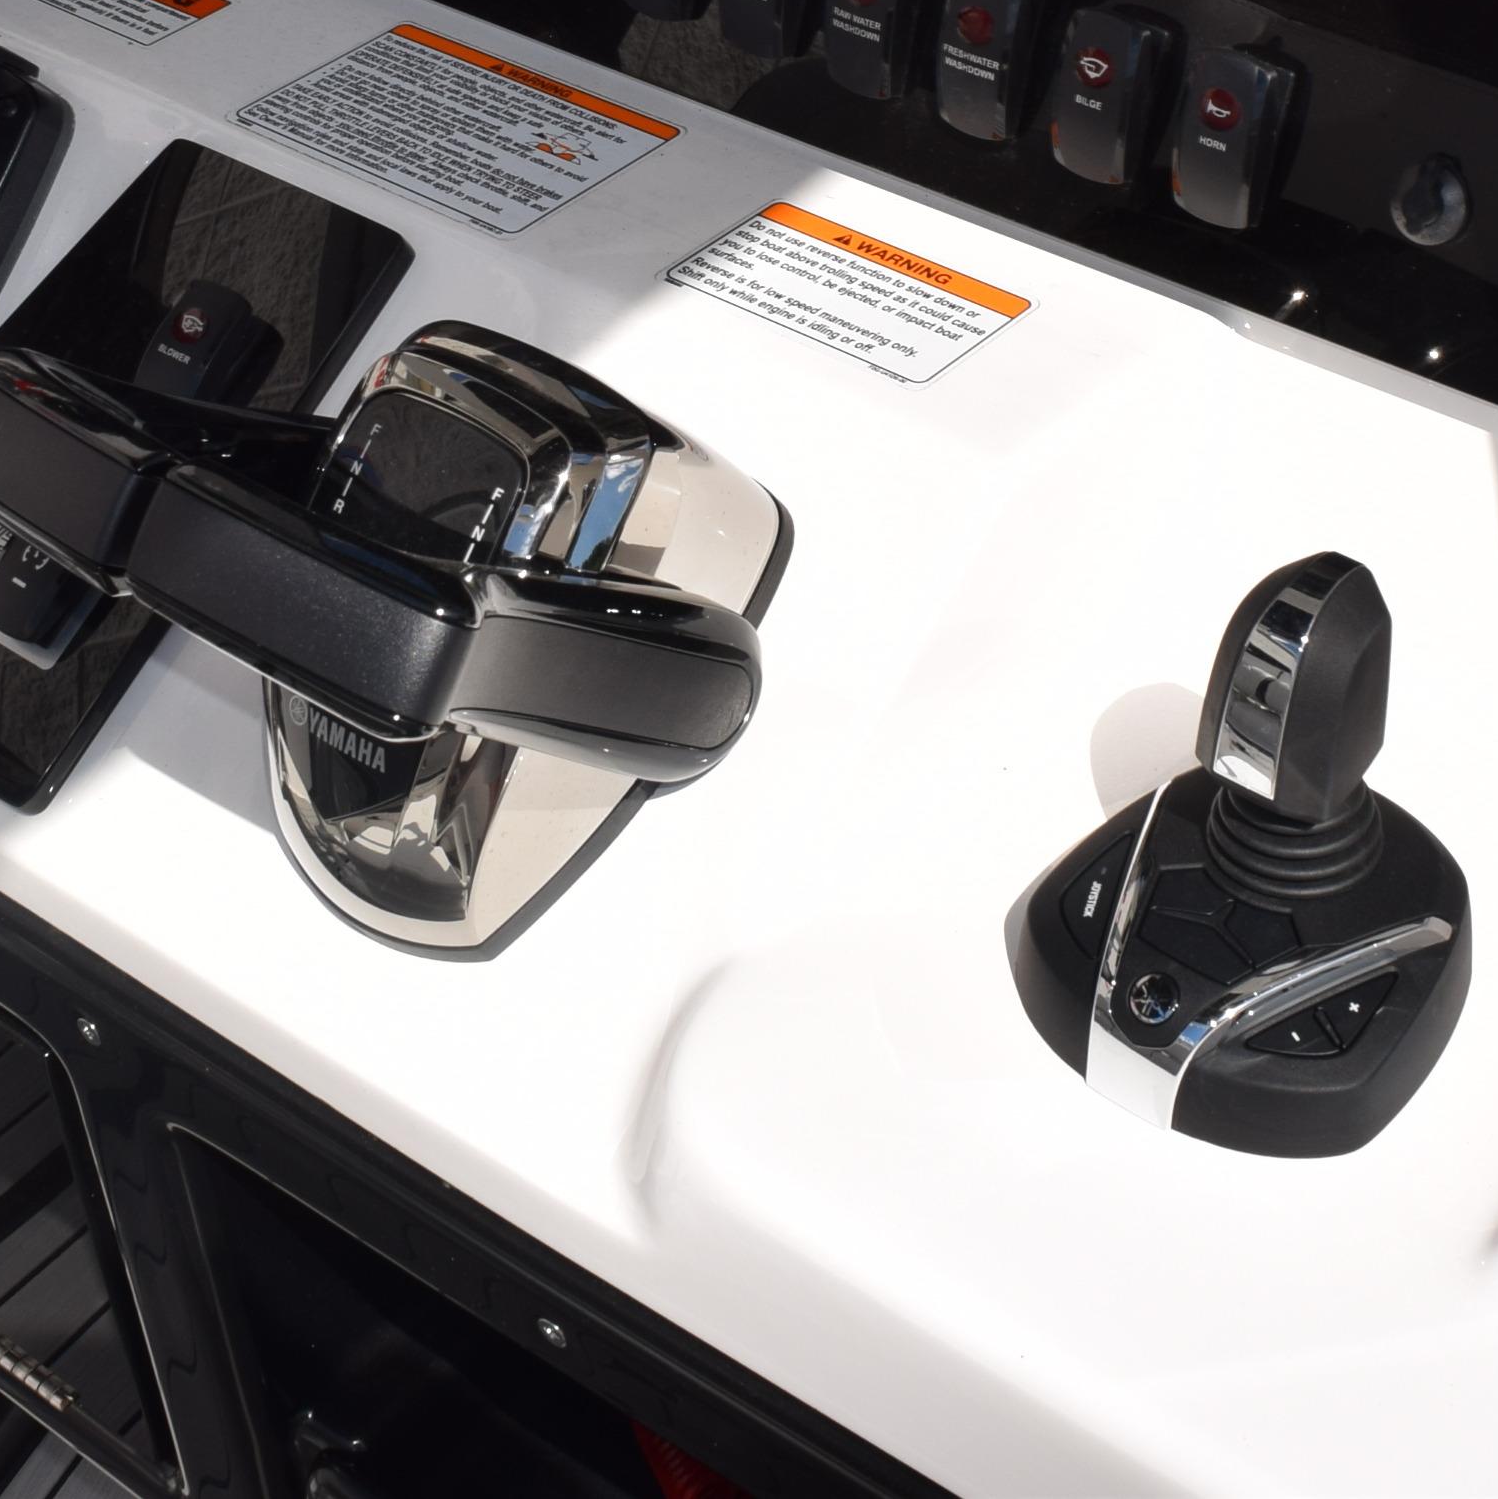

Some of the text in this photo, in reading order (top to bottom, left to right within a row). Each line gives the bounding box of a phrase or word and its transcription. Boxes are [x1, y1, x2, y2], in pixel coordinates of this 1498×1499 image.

[832, 18, 881, 43] WASHDOWN
[833, 6, 882, 31] RAW WATER
[943, 43, 1001, 71] FRESHWATER
[944, 56, 995, 82] WASHDOWN
[507, 70, 573, 98] WARNING
[1075, 94, 1103, 111] BILGE
[1198, 134, 1227, 152] HORN
[707, 247, 754, 270] surfaces.
[747, 219, 981, 318] Do not use reverse function to slow down or
[856, 240, 952, 284] WARNING
[719, 237, 963, 341] you to lose control, be ejected, or impact boat
[734, 229, 986, 336] stop boat above trolling speed as it could cause
[676, 264, 706, 281] Shift
[702, 277, 730, 292] only
[728, 288, 758, 304] while
[757, 300, 796, 320] engine
[794, 314, 808, 325] is
[806, 319, 841, 340] idling
[838, 335, 856, 344] or
[853, 341, 875, 354] off.
[690, 255, 918, 358] Reverse is for low speed maneuvering only.
[157, 343, 191, 365] BLOWER
[370, 423, 382, 436] F
[350, 460, 363, 476] N
[333, 498, 346, 514] R
[491, 487, 505, 501] F
[471, 525, 486, 542] N
[309, 706, 386, 774] YAMAHA
[1083, 880, 1102, 919] JOYSTICK
